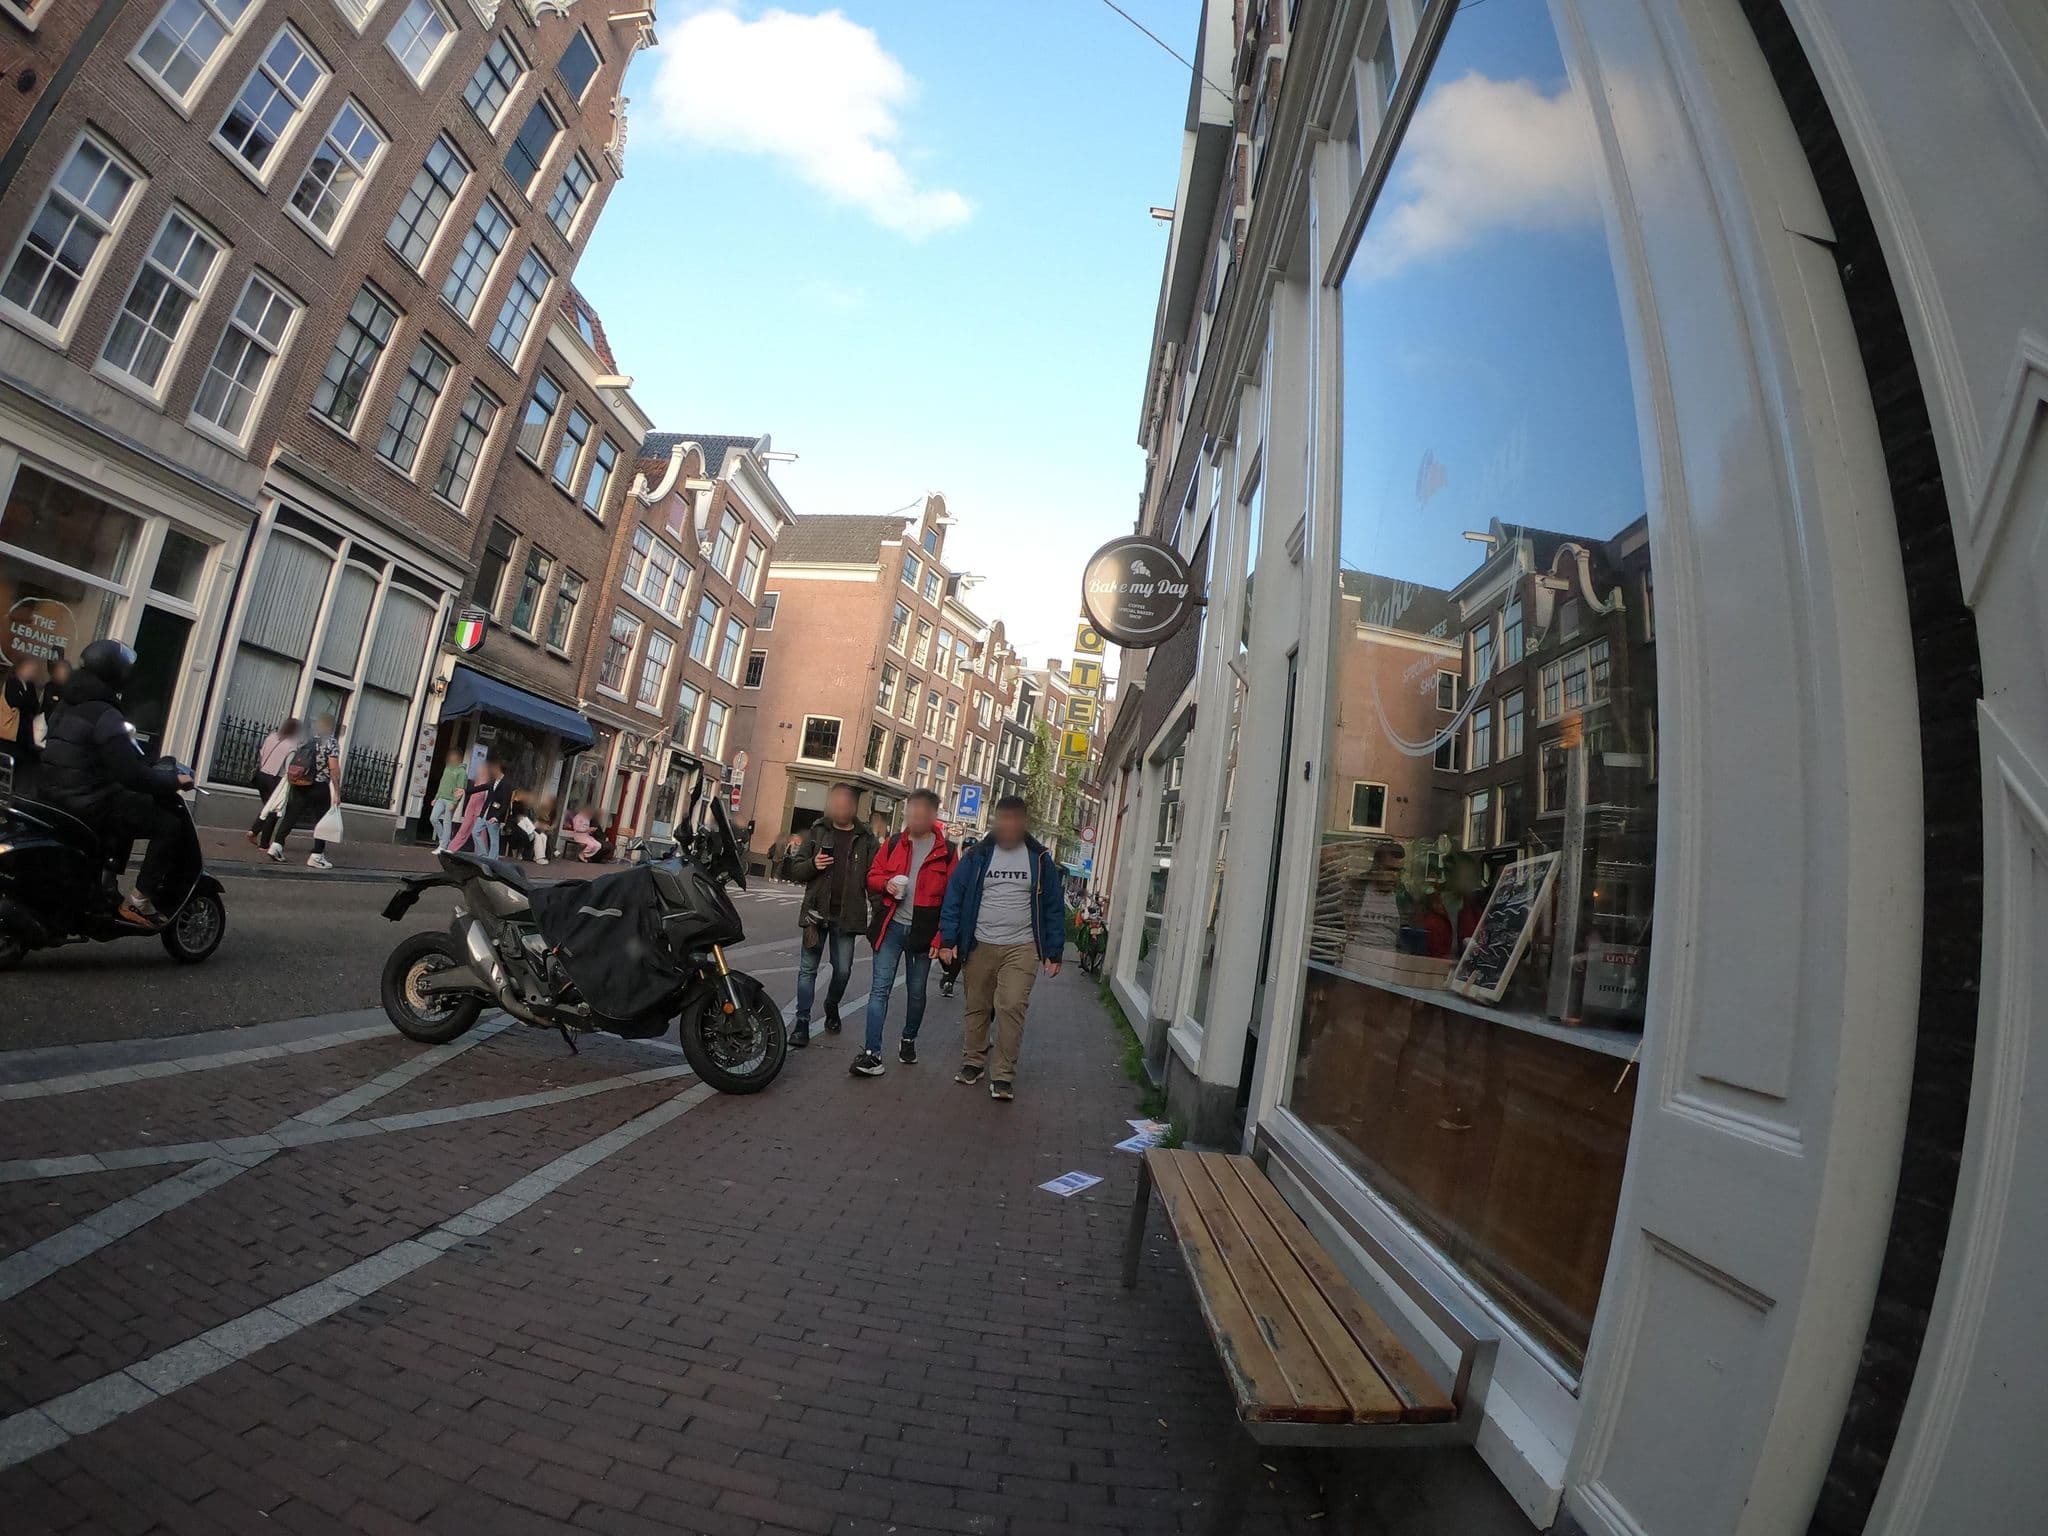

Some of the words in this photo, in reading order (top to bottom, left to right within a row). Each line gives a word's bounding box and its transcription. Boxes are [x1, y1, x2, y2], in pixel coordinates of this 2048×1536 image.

[1088, 579, 1128, 594] Bake
[1129, 582, 1154, 598] my
[1157, 579, 1189, 598] Day
[33, 614, 56, 630] THE
[10, 621, 69, 648] LEBANESE
[1065, 627, 1102, 756] OTEL
[964, 788, 976, 803] P
[986, 870, 1028, 880] ACTIVE
